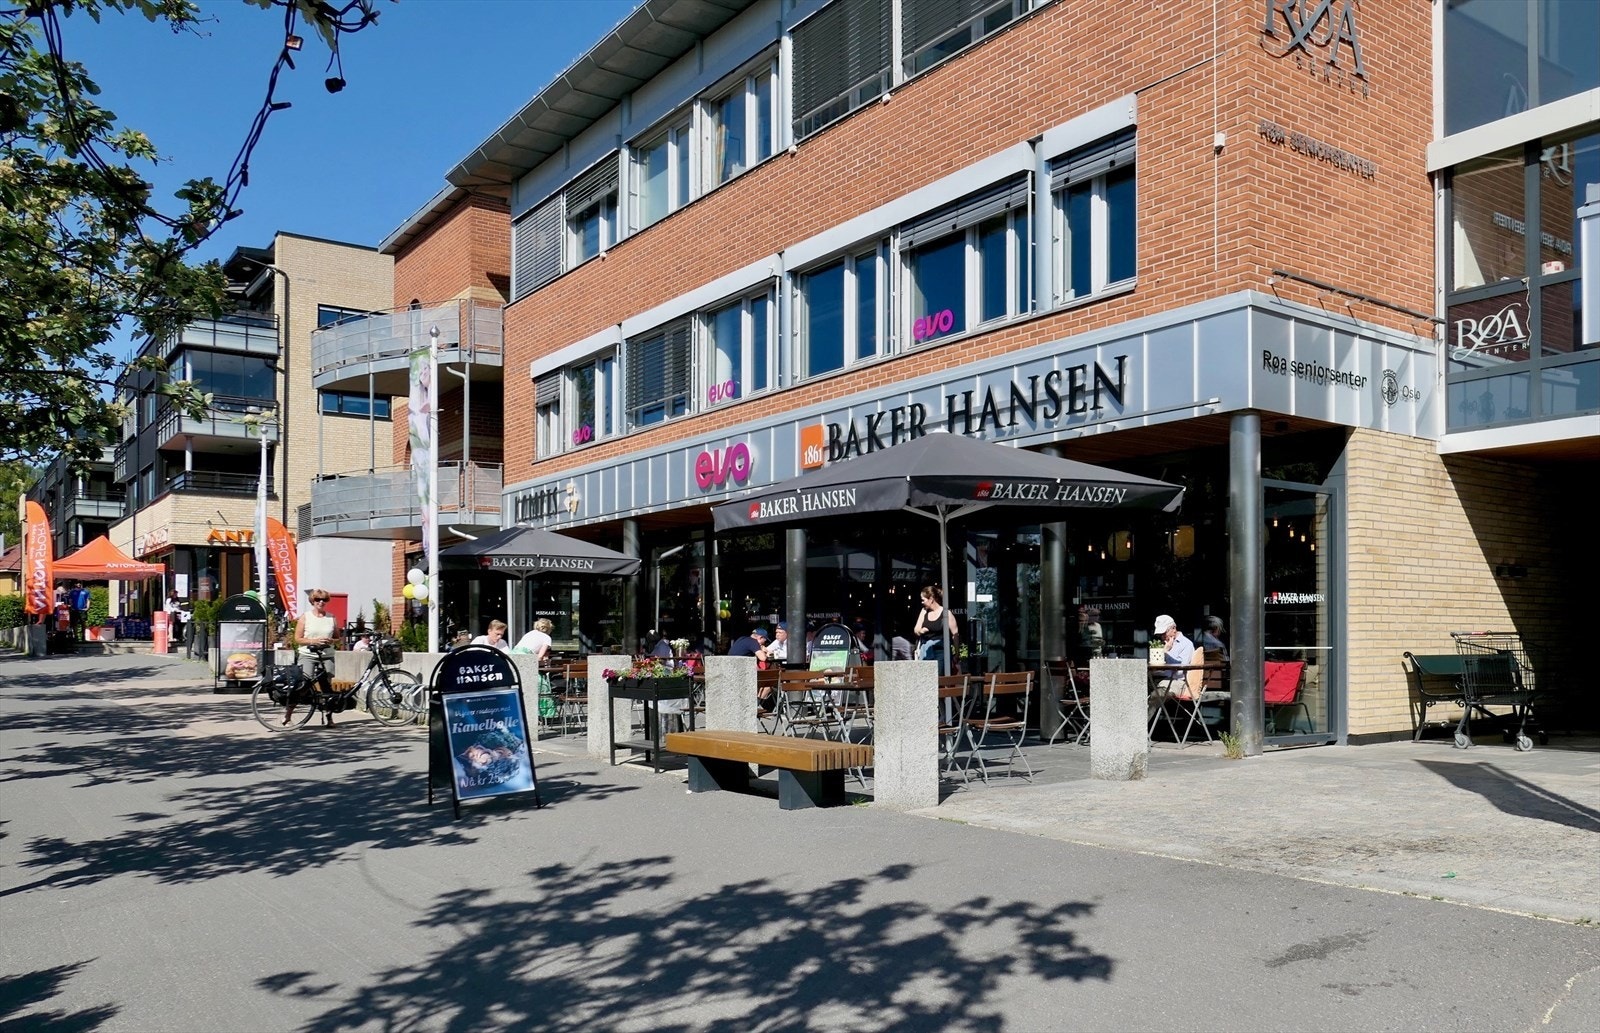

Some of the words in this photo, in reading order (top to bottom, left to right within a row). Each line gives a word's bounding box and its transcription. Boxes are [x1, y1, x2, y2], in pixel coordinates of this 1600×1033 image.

[913, 308, 954, 341] evo
[1453, 302, 1527, 361] RØA
[1476, 342, 1528, 358] SENTER
[1262, 349, 1287, 370] Røa
[1290, 360, 1368, 388] seniorsenter
[708, 379, 736, 402] evo
[1402, 385, 1421, 400] Oslo
[827, 402, 927, 462] BAKER
[945, 355, 1128, 435] HANSEN
[573, 425, 592, 446] evo
[803, 443, 823, 466] 1861
[694, 442, 752, 490] evo
[759, 497, 798, 518] BAKER
[802, 488, 857, 510] HANSEN
[991, 483, 1049, 500] BAKER
[1053, 485, 1128, 504] HANSEN
[207, 528, 254, 545] ANT
[492, 557, 535, 567] BAKER
[540, 558, 595, 570] HANSEN
[1104, 602, 1131, 611] HANSEN
[1278, 592, 1298, 601] BAKER
[1299, 593, 1325, 602] HANSEN
[452, 716, 519, 735] Kanelbolle
